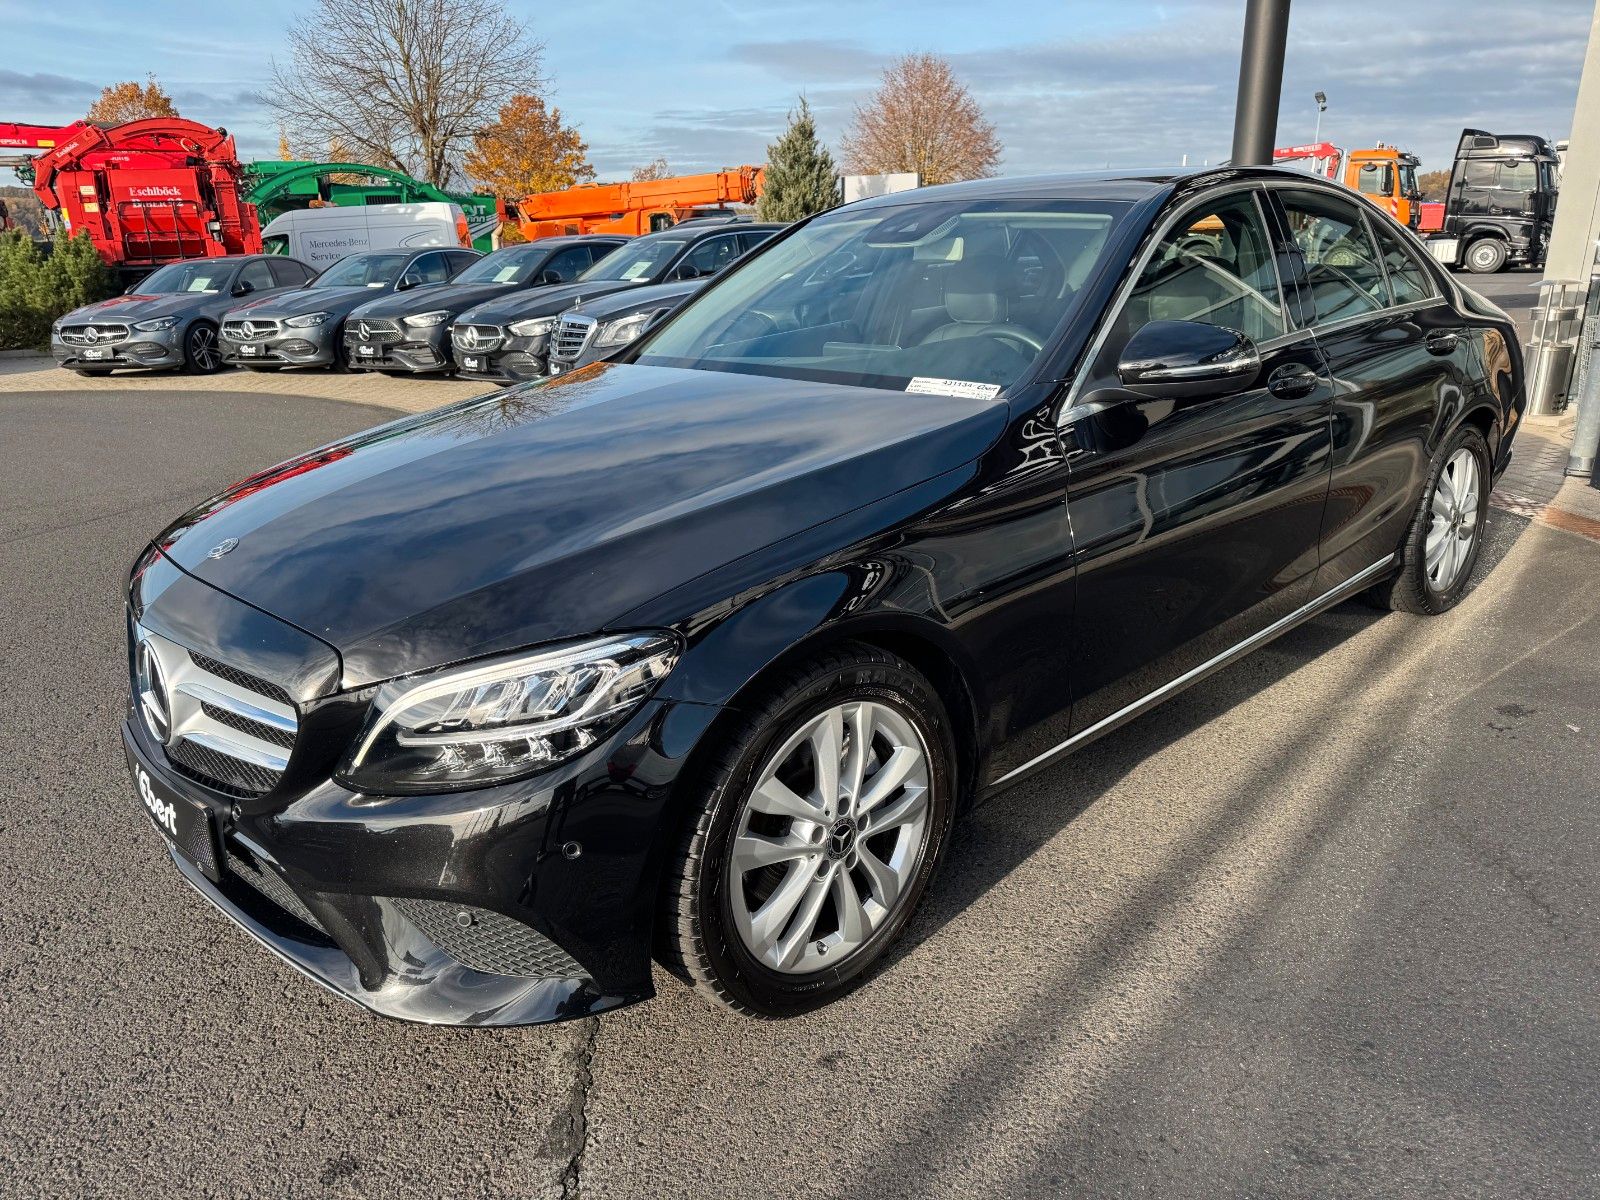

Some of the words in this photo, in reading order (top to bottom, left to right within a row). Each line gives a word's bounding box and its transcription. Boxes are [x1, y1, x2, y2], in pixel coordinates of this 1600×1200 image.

[129, 186, 182, 197] Eschlböck
[309, 238, 368, 249] Mercedes-Benz
[310, 252, 341, 261] Service
[138, 769, 177, 836] Ebert
